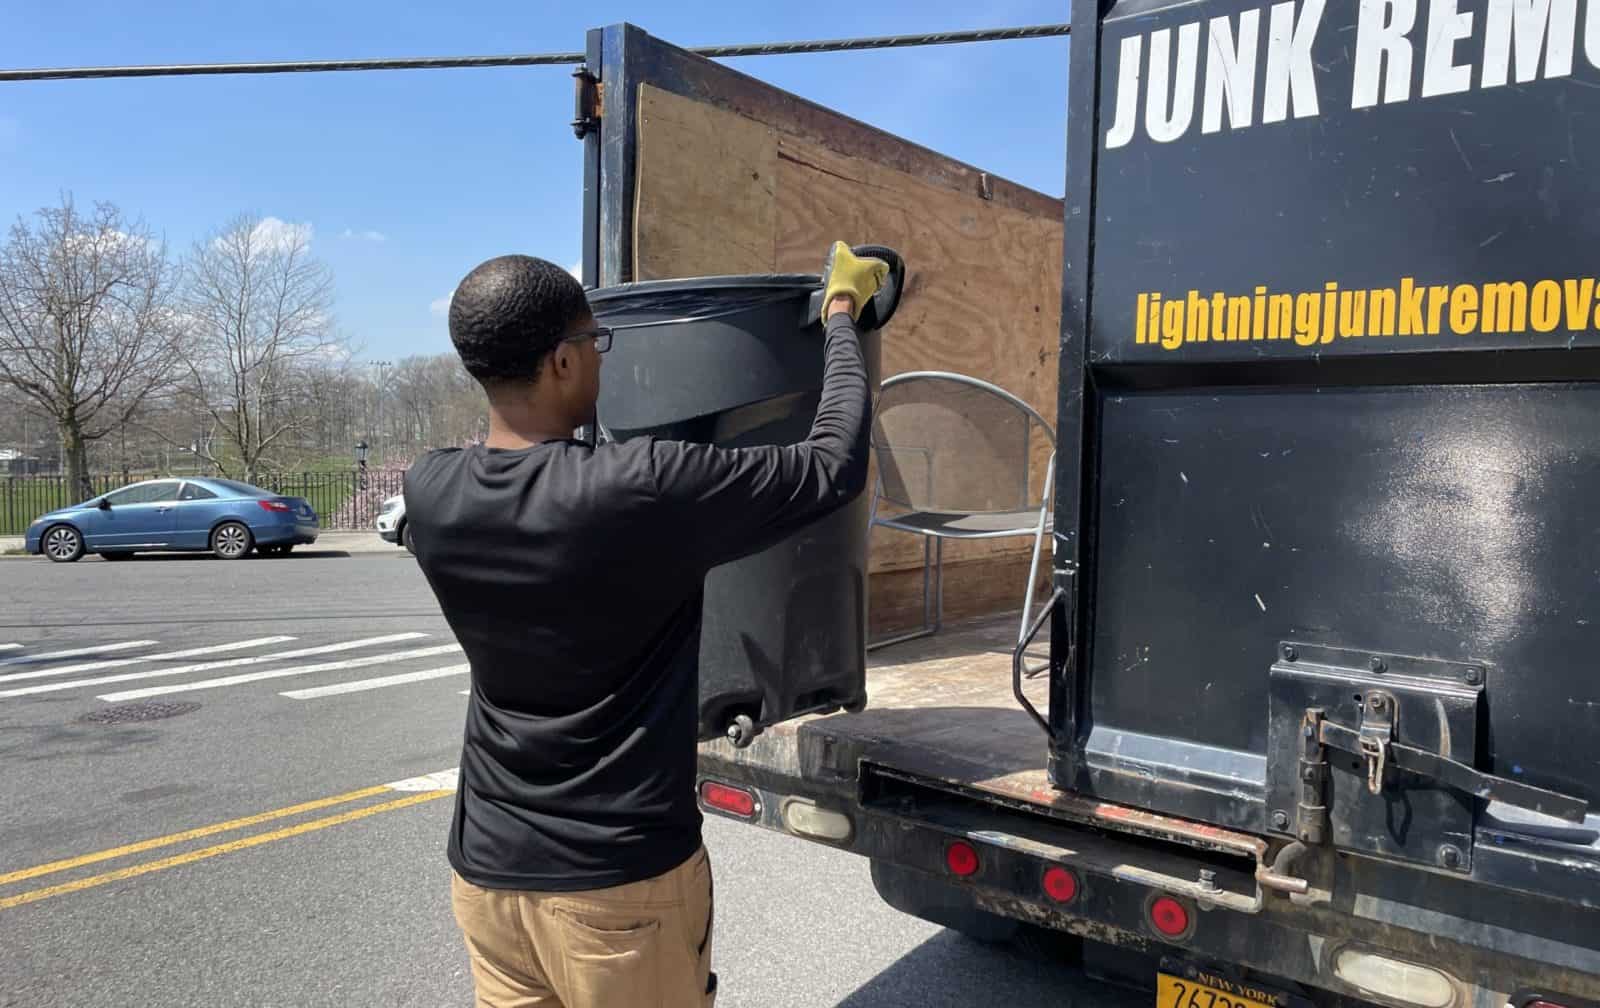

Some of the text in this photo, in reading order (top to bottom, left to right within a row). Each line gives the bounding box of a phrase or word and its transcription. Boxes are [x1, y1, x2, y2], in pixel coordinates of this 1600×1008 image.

[1105, 0, 1325, 149] JUNK
[1135, 278, 1600, 350] lightningjunkremov
[1199, 972, 1279, 1005] NEW YORK
